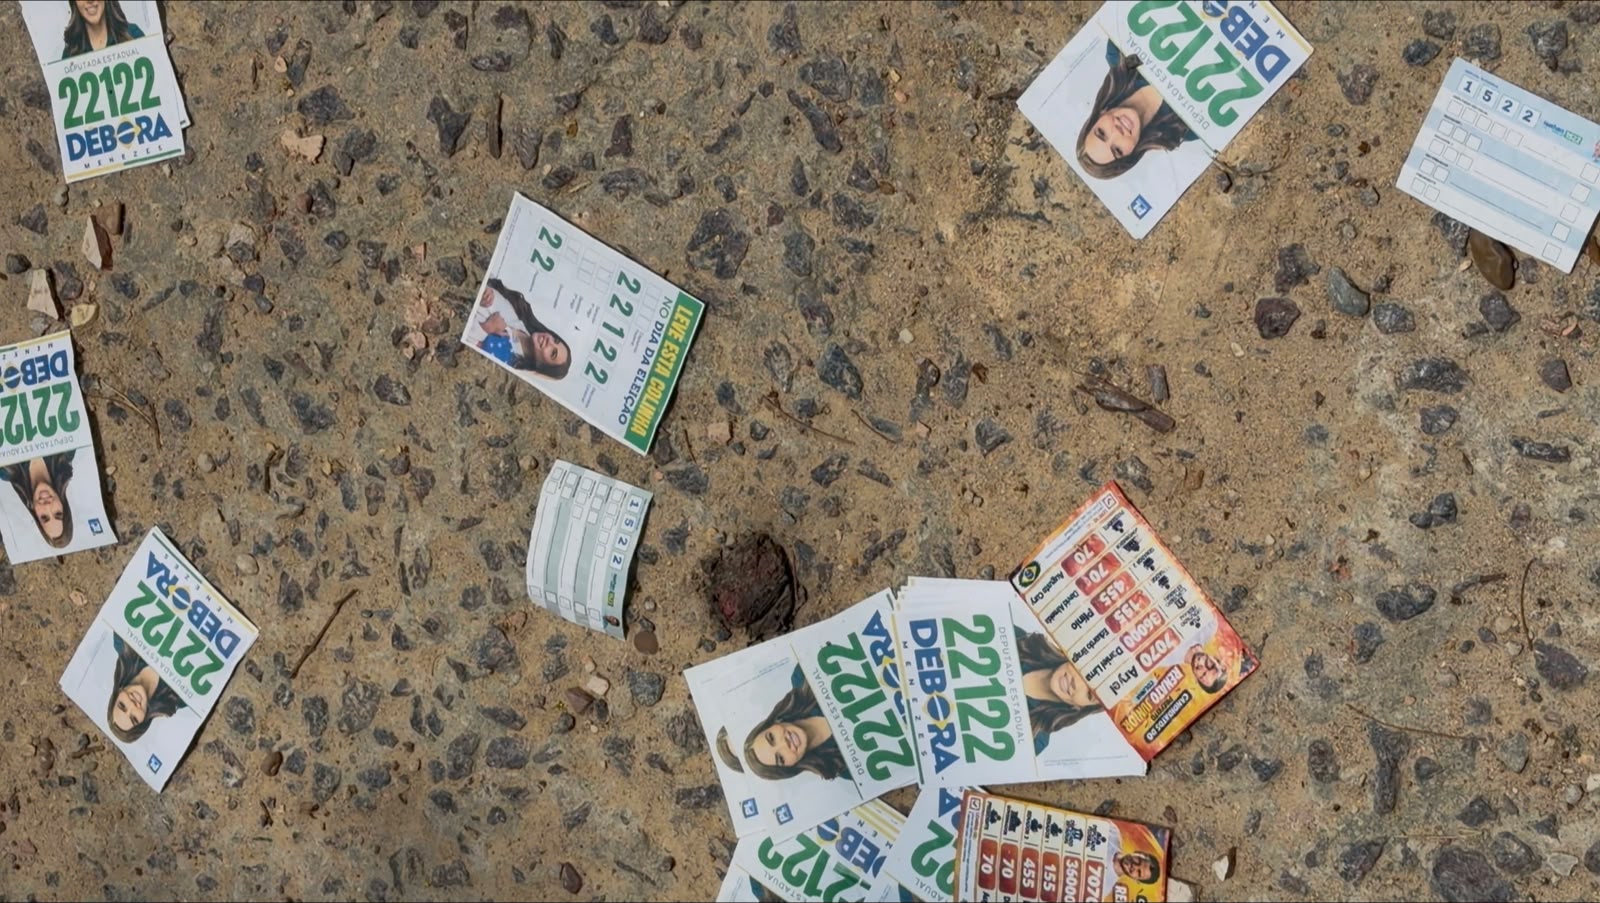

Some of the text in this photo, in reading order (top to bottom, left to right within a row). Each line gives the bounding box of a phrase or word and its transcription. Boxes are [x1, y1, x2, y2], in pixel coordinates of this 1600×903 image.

[64, 48, 140, 74] DEPUTADA ESTADUAL
[1128, 0, 1264, 128] 22122
[58, 56, 162, 130] 22122
[1126, 37, 1210, 130] DEPUTADA ESTADUAL
[84, 145, 163, 169] MENEZES
[659, 296, 674, 318] NO
[672, 304, 694, 344] LEVE
[649, 320, 664, 346] DIA
[642, 347, 654, 366] DA
[656, 342, 680, 378] ESTA
[0, 381, 80, 448] 2212
[618, 369, 646, 426] ELEIÇÃO
[630, 376, 666, 436] COLINHA
[36, 435, 74, 450] DEPUTADA
[1074, 544, 1094, 564] 70
[164, 554, 234, 624] MENEZES
[1030, 592, 1044, 606] Cury
[1042, 570, 1064, 594] Augusto
[1064, 590, 1080, 608] David
[1100, 580, 1125, 606] 455
[1044, 604, 1065, 624] Almeida
[1123, 614, 1162, 650] 36000
[124, 580, 224, 696] 22122
[126, 628, 160, 666] ESTADUAL
[1087, 628, 1110, 650] Eduardo
[1140, 632, 1172, 668] 7070
[1086, 664, 1104, 682] Lima
[1102, 646, 1124, 669] Daniel
[160, 662, 194, 698] DEPUTADA
[942, 614, 1016, 764] 22122
[998, 626, 1025, 744] DEPUTADA ESTADUAL
[1110, 665, 1138, 696] Aryel
[1150, 666, 1184, 704] RENATO
[817, 632, 915, 781] 22122
[902, 640, 927, 758] MENEZES
[1146, 692, 1190, 741] CANDIDATOS DO
[812, 668, 864, 776] DEPUTADA ESTADUAL
[981, 854, 994, 874] 70
[1002, 858, 1014, 879] 70
[1022, 857, 1036, 888] 455
[1042, 864, 1056, 892] 155
[1064, 859, 1079, 902] 36000
